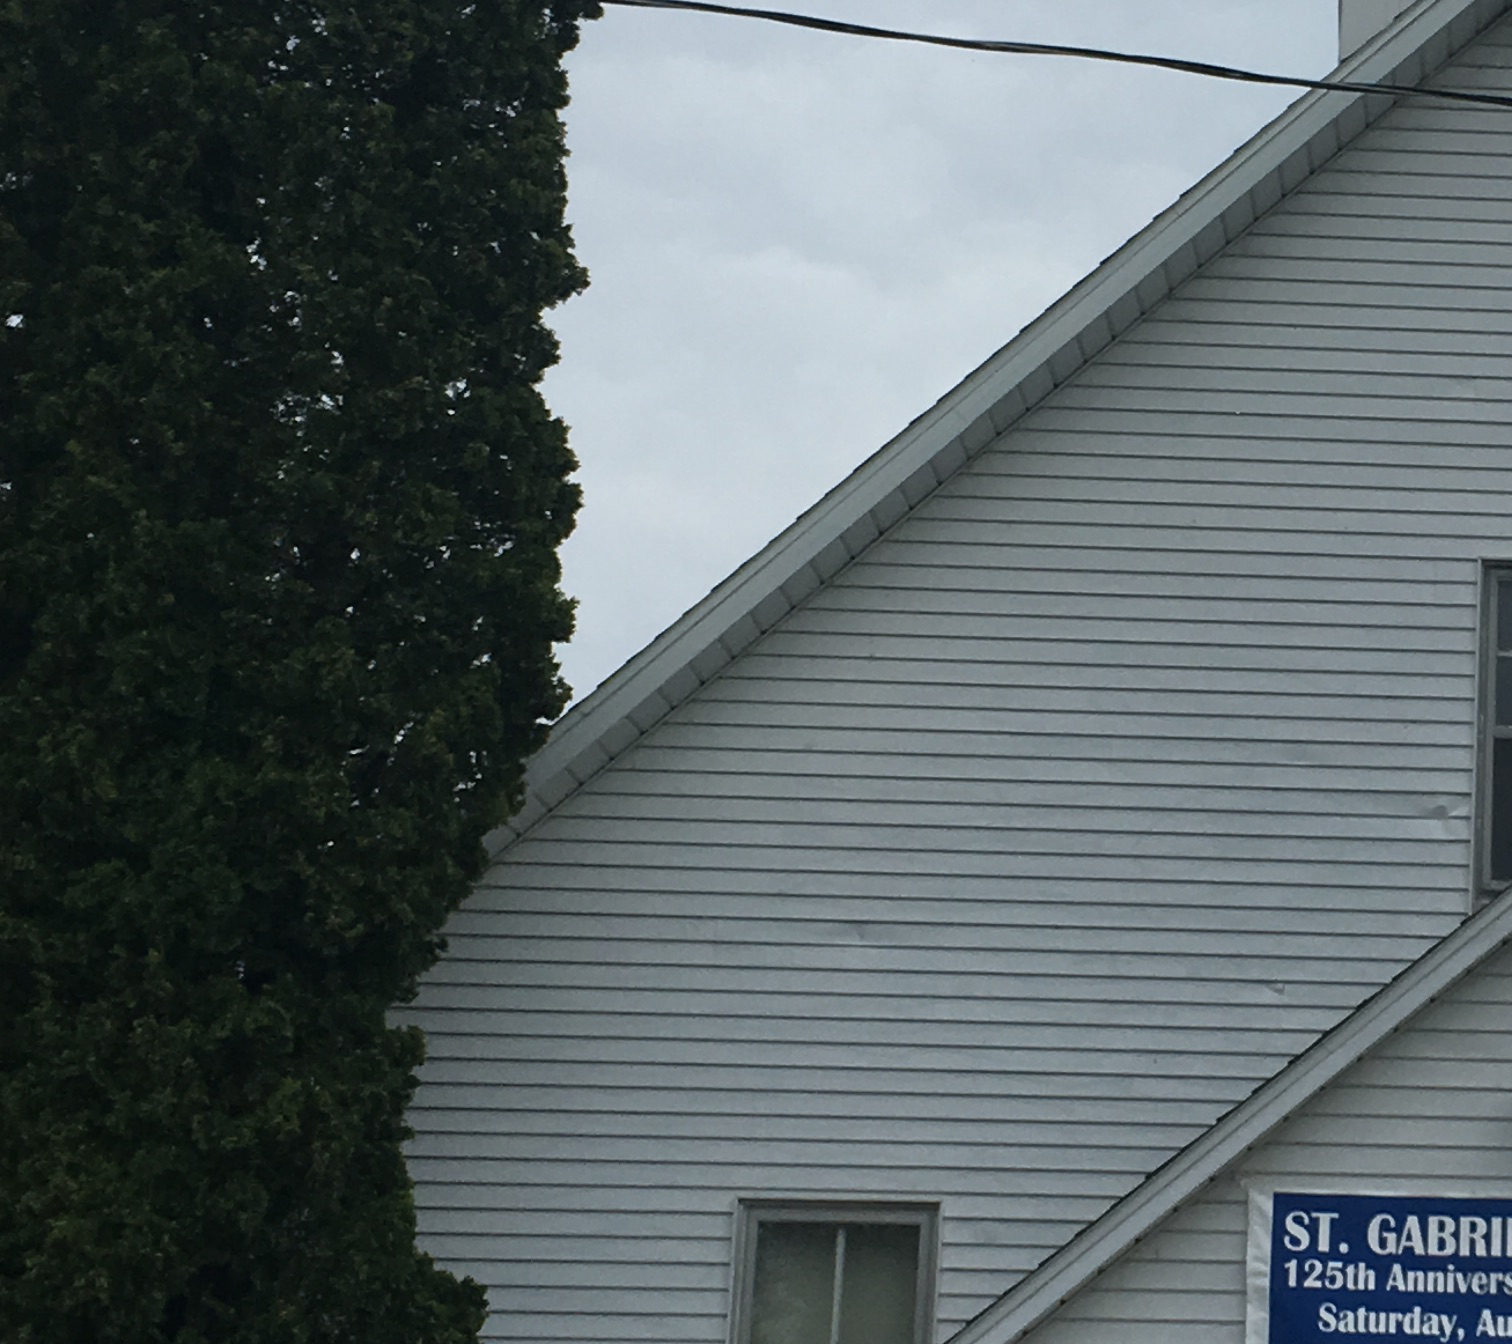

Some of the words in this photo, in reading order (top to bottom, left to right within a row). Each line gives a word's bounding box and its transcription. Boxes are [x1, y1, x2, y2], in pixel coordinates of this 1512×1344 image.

[1283, 1211, 1349, 1254] ST.
[1283, 1260, 1376, 1292] 125th
[1317, 1302, 1465, 1342] Saturday,
